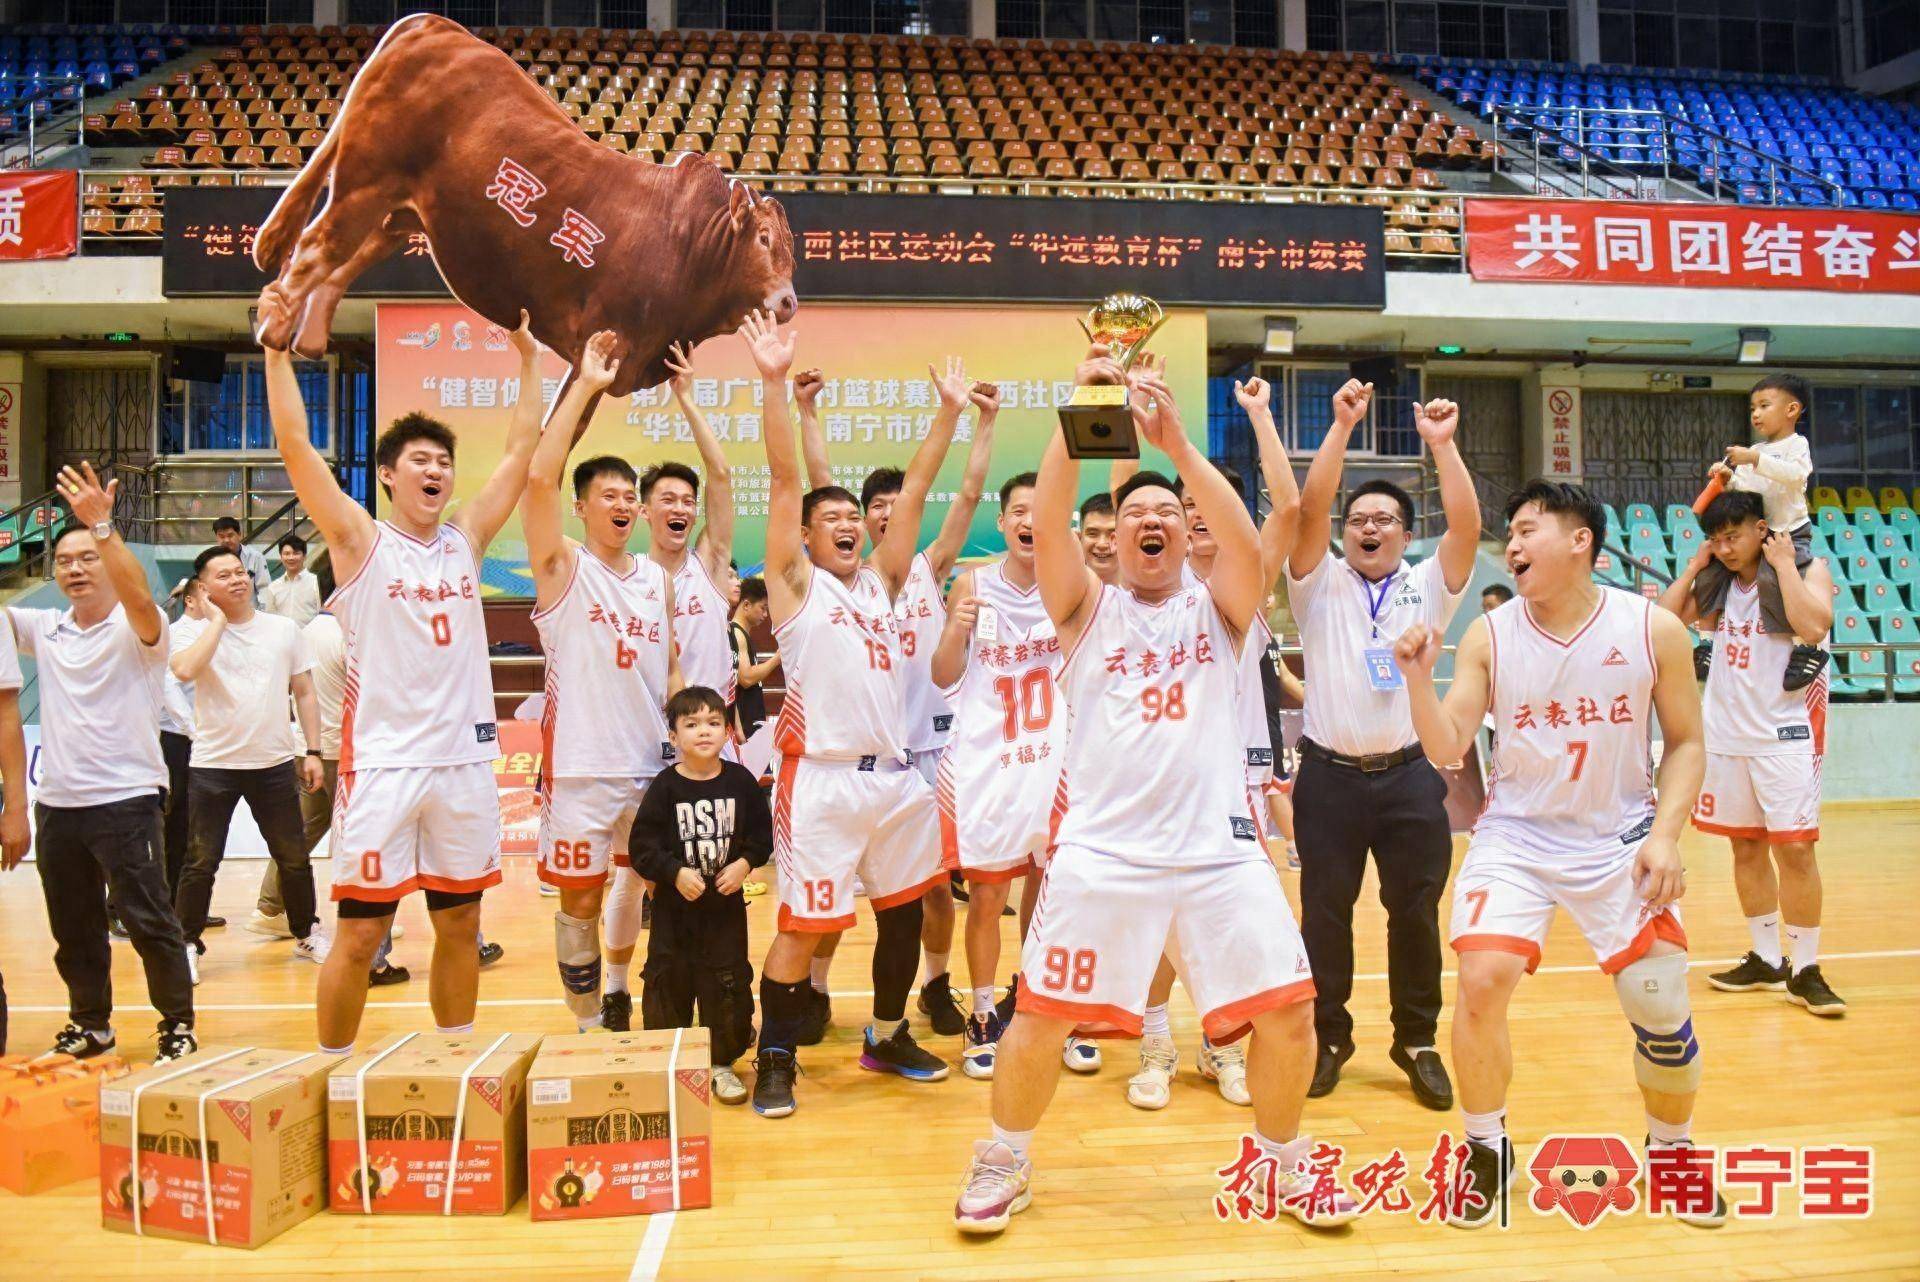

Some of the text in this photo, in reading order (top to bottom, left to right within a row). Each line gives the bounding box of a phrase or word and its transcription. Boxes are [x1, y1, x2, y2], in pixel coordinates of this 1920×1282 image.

[486, 155, 606, 271] 冠军
[626, 412, 802, 443] “华远教育”
[1551, 416, 1572, 474] 禁止吸烟
[432, 612, 452, 647] 0
[864, 638, 892, 672] 13
[1104, 633, 1215, 678] 云表社区
[1726, 643, 1751, 669] 99
[993, 666, 1055, 744] 10
[1140, 680, 1188, 723] 98
[1512, 696, 1636, 730] 云表社区
[1566, 741, 1591, 783] 7
[675, 798, 737, 842] DSM
[361, 849, 383, 883] 0
[554, 838, 592, 871] 66
[804, 880, 836, 913] 13
[1465, 887, 1490, 929] 7
[1042, 945, 1098, 994] 98
